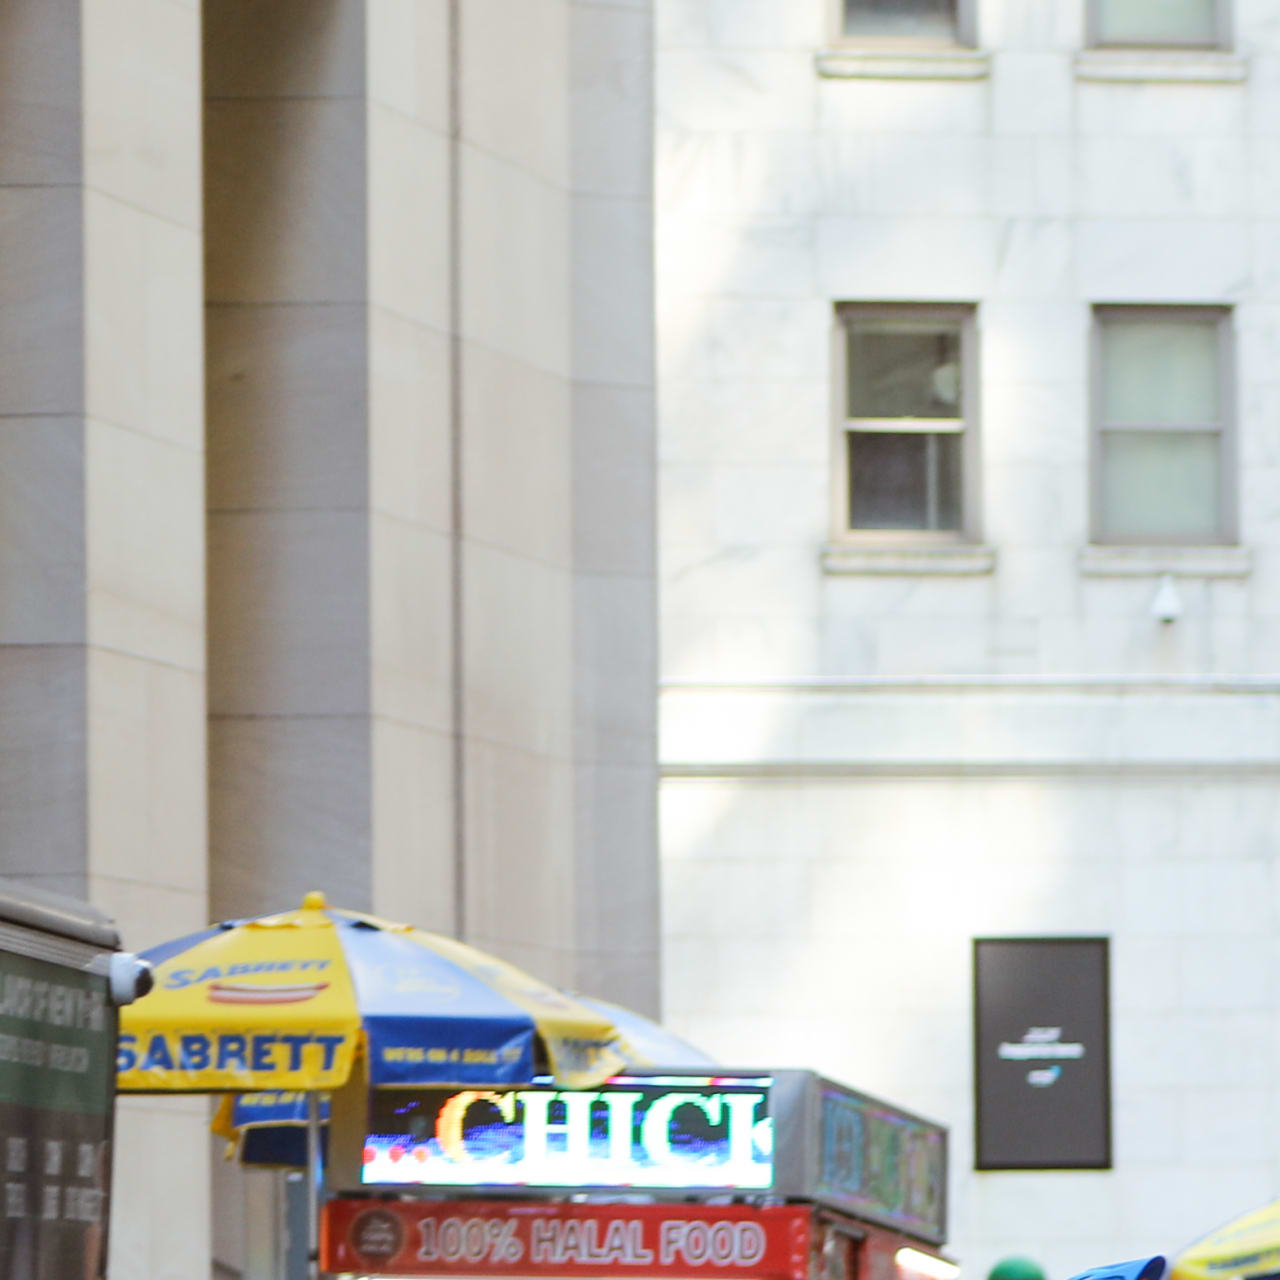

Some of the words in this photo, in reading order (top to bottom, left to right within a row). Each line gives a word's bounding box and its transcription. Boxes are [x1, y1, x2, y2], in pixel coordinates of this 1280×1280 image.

[163, 960, 332, 990] SABRETT
[118, 1034, 345, 1073] SABRETT
[417, 1217, 523, 1263] 100%
[530, 1219, 654, 1264] HALAL
[660, 1220, 766, 1266] FOOD
